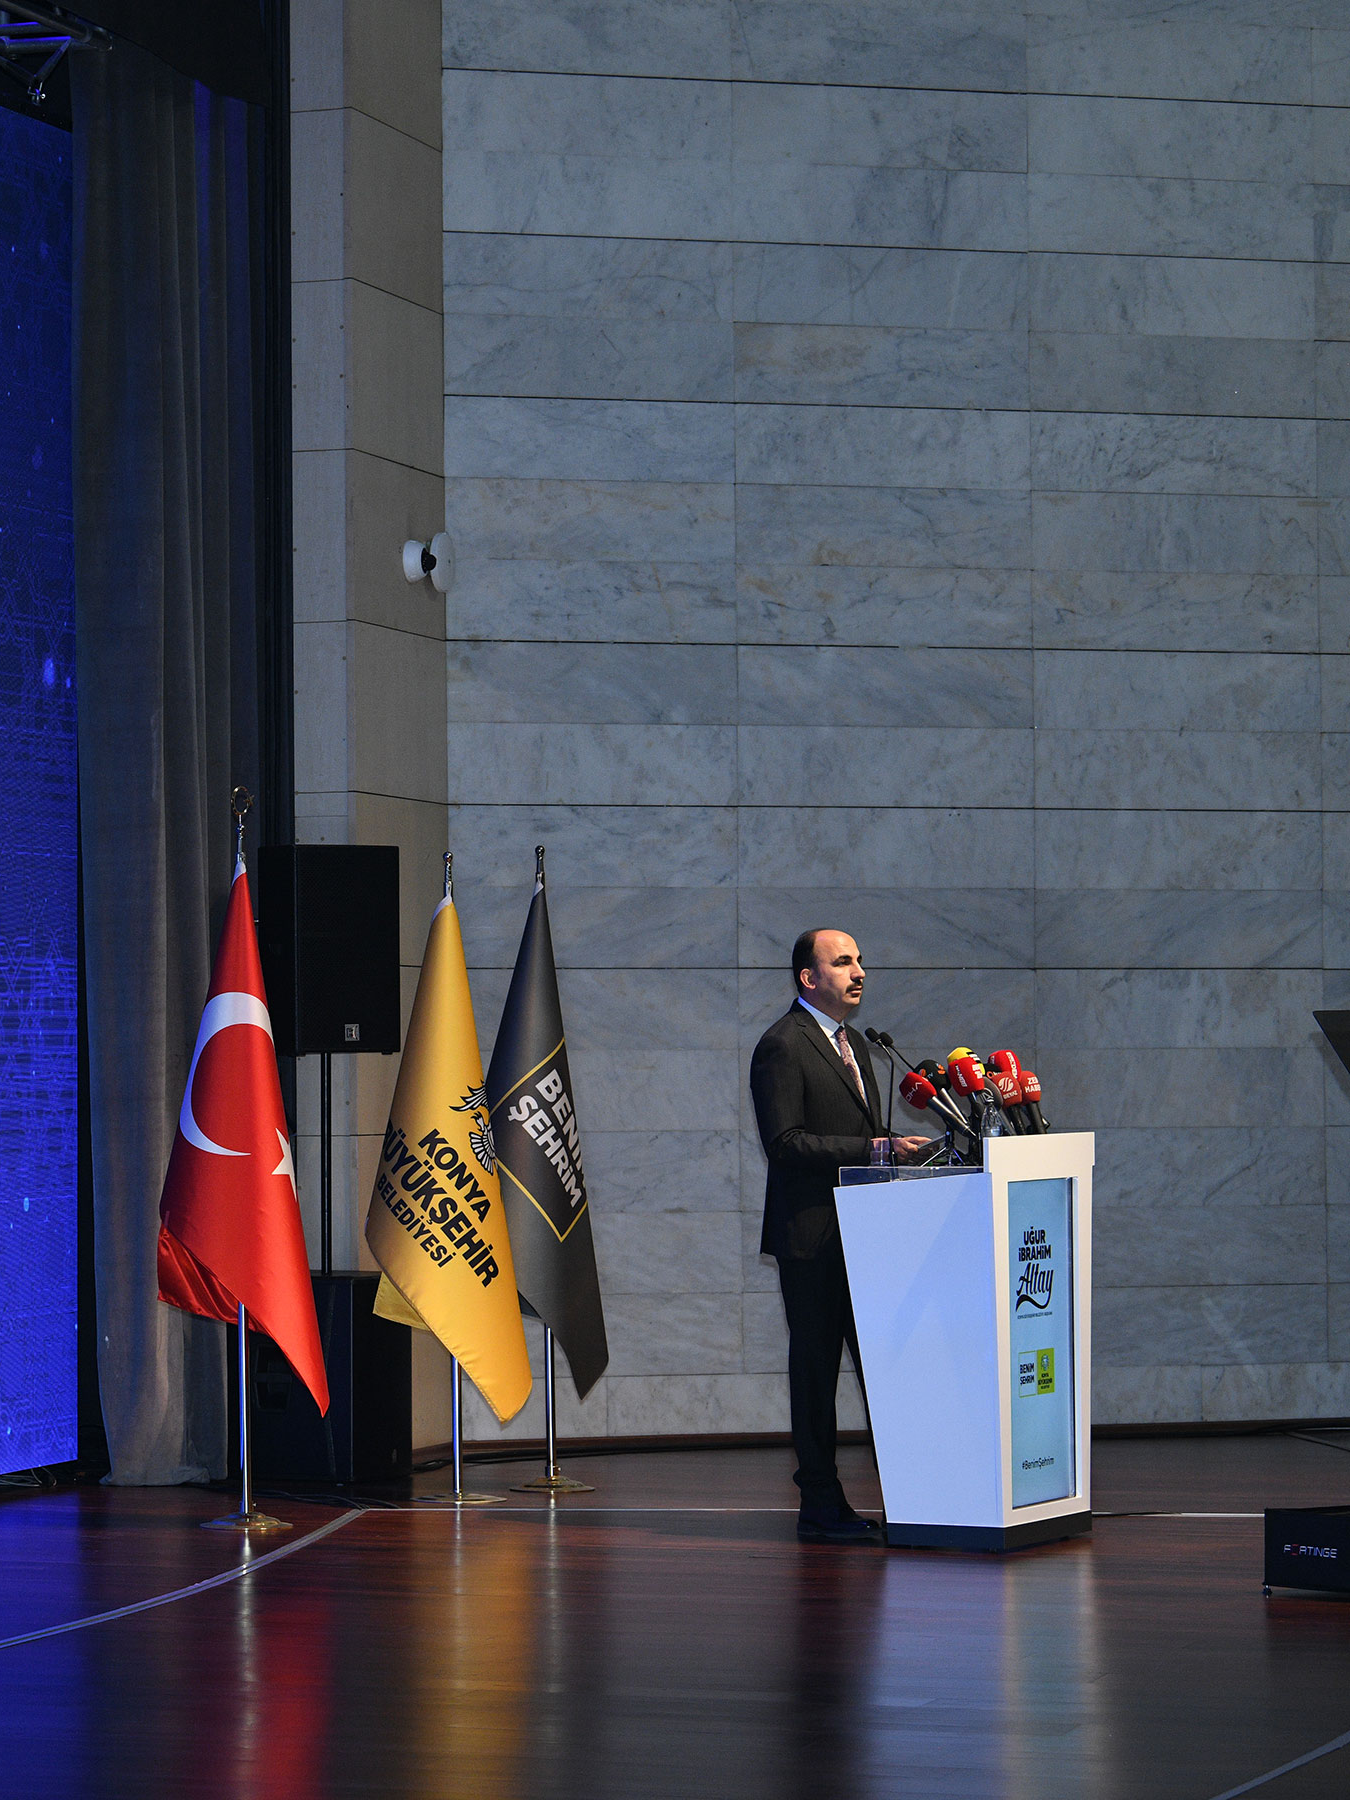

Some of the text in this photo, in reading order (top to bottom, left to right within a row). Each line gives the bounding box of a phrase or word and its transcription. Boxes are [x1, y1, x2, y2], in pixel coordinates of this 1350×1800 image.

[418, 1128, 491, 1223] KONYA
[508, 1095, 582, 1208] ŞEHRİM
[377, 1173, 457, 1268] BELEDİYESİ
[1015, 1262, 1054, 1312] Altay
